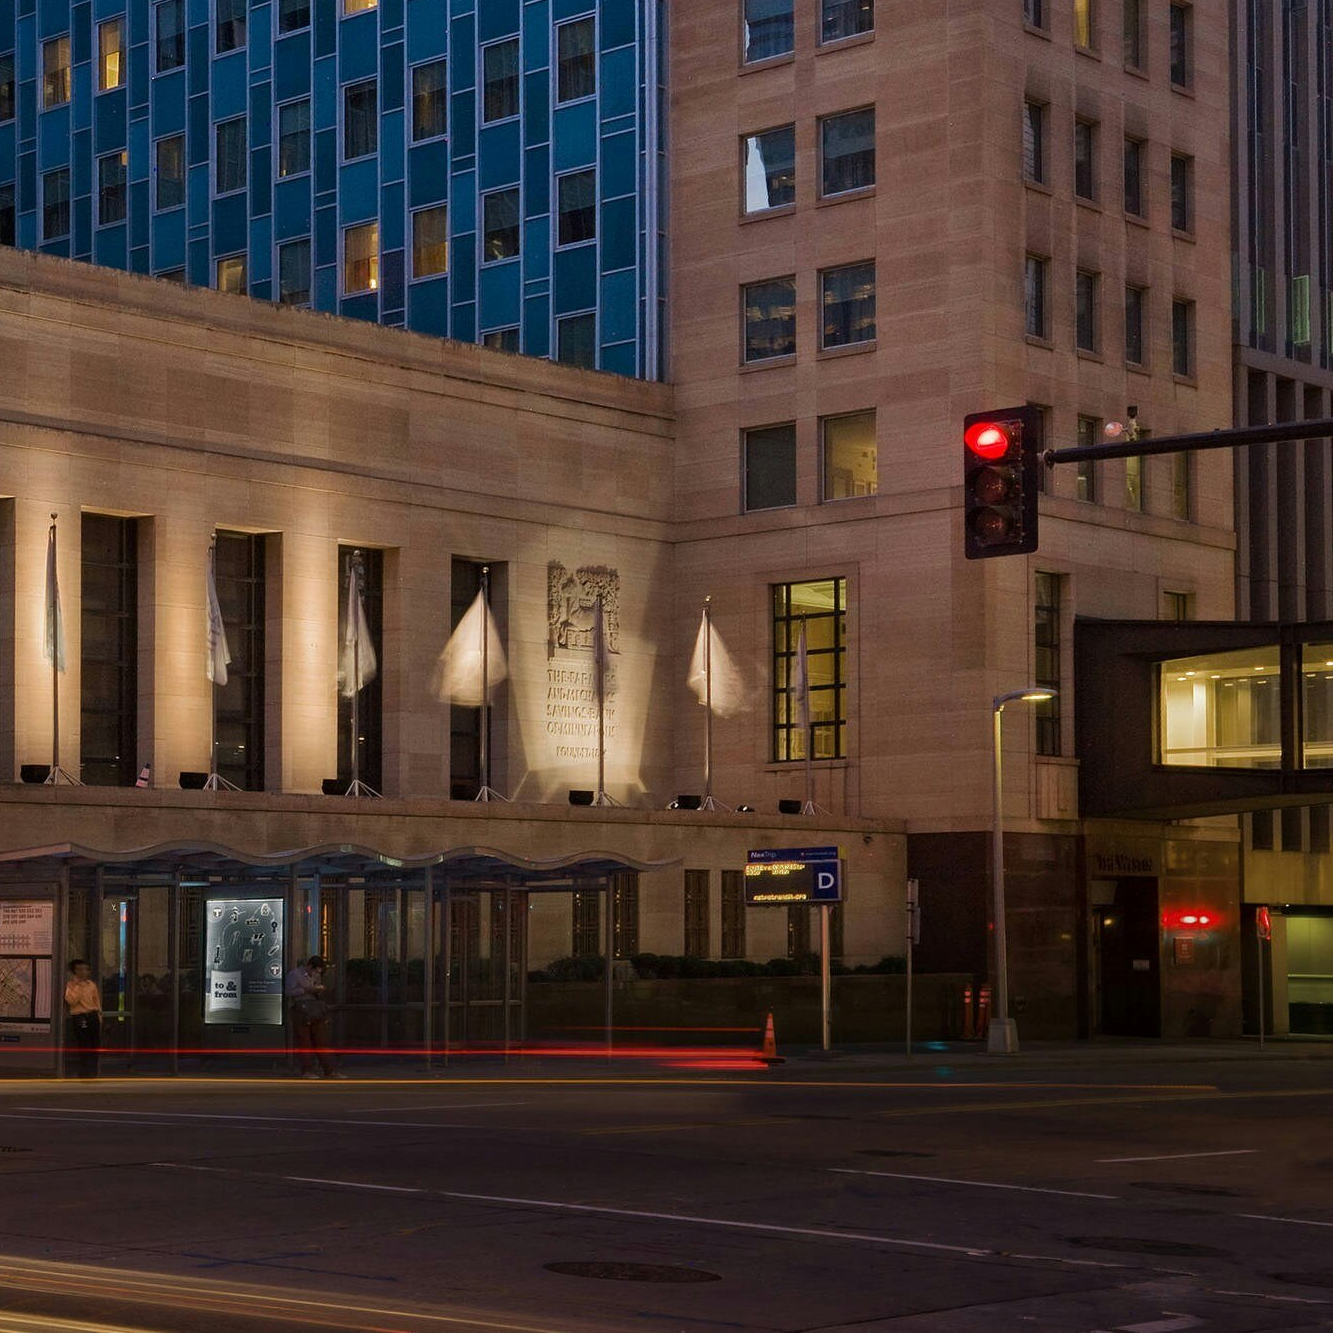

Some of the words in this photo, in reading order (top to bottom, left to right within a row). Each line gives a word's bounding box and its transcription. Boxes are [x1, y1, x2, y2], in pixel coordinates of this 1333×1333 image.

[817, 872, 835, 890] D
[214, 981, 224, 990] to
[226, 981, 237, 992] &
[214, 990, 238, 999] from
